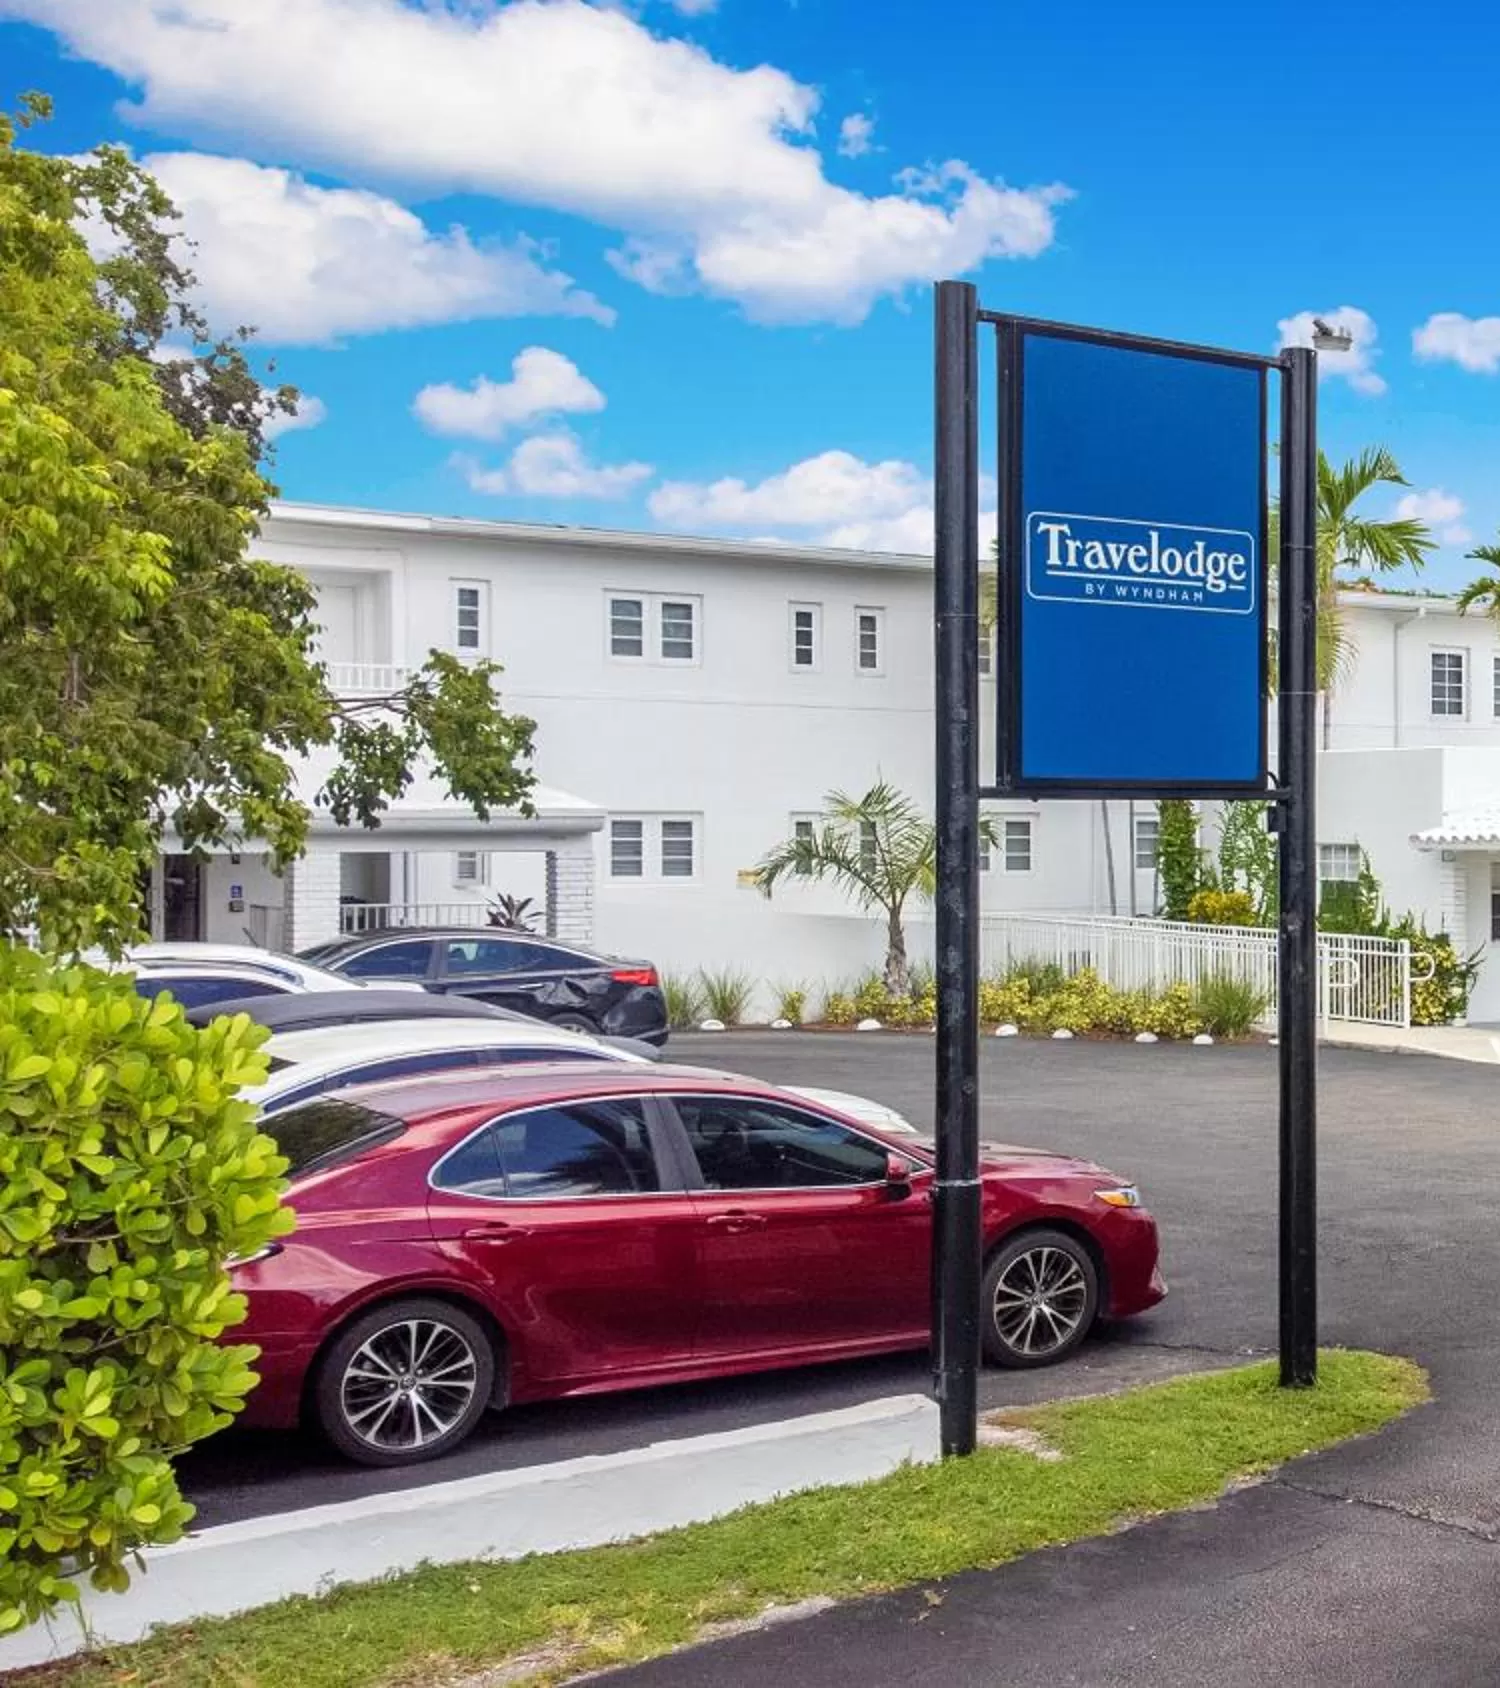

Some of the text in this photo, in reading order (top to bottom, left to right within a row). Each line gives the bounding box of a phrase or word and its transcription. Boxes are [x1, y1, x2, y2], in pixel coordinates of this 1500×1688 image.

[1037, 521, 1247, 592] Travelodge
[1085, 582, 1203, 602] BY WYNDHAM
